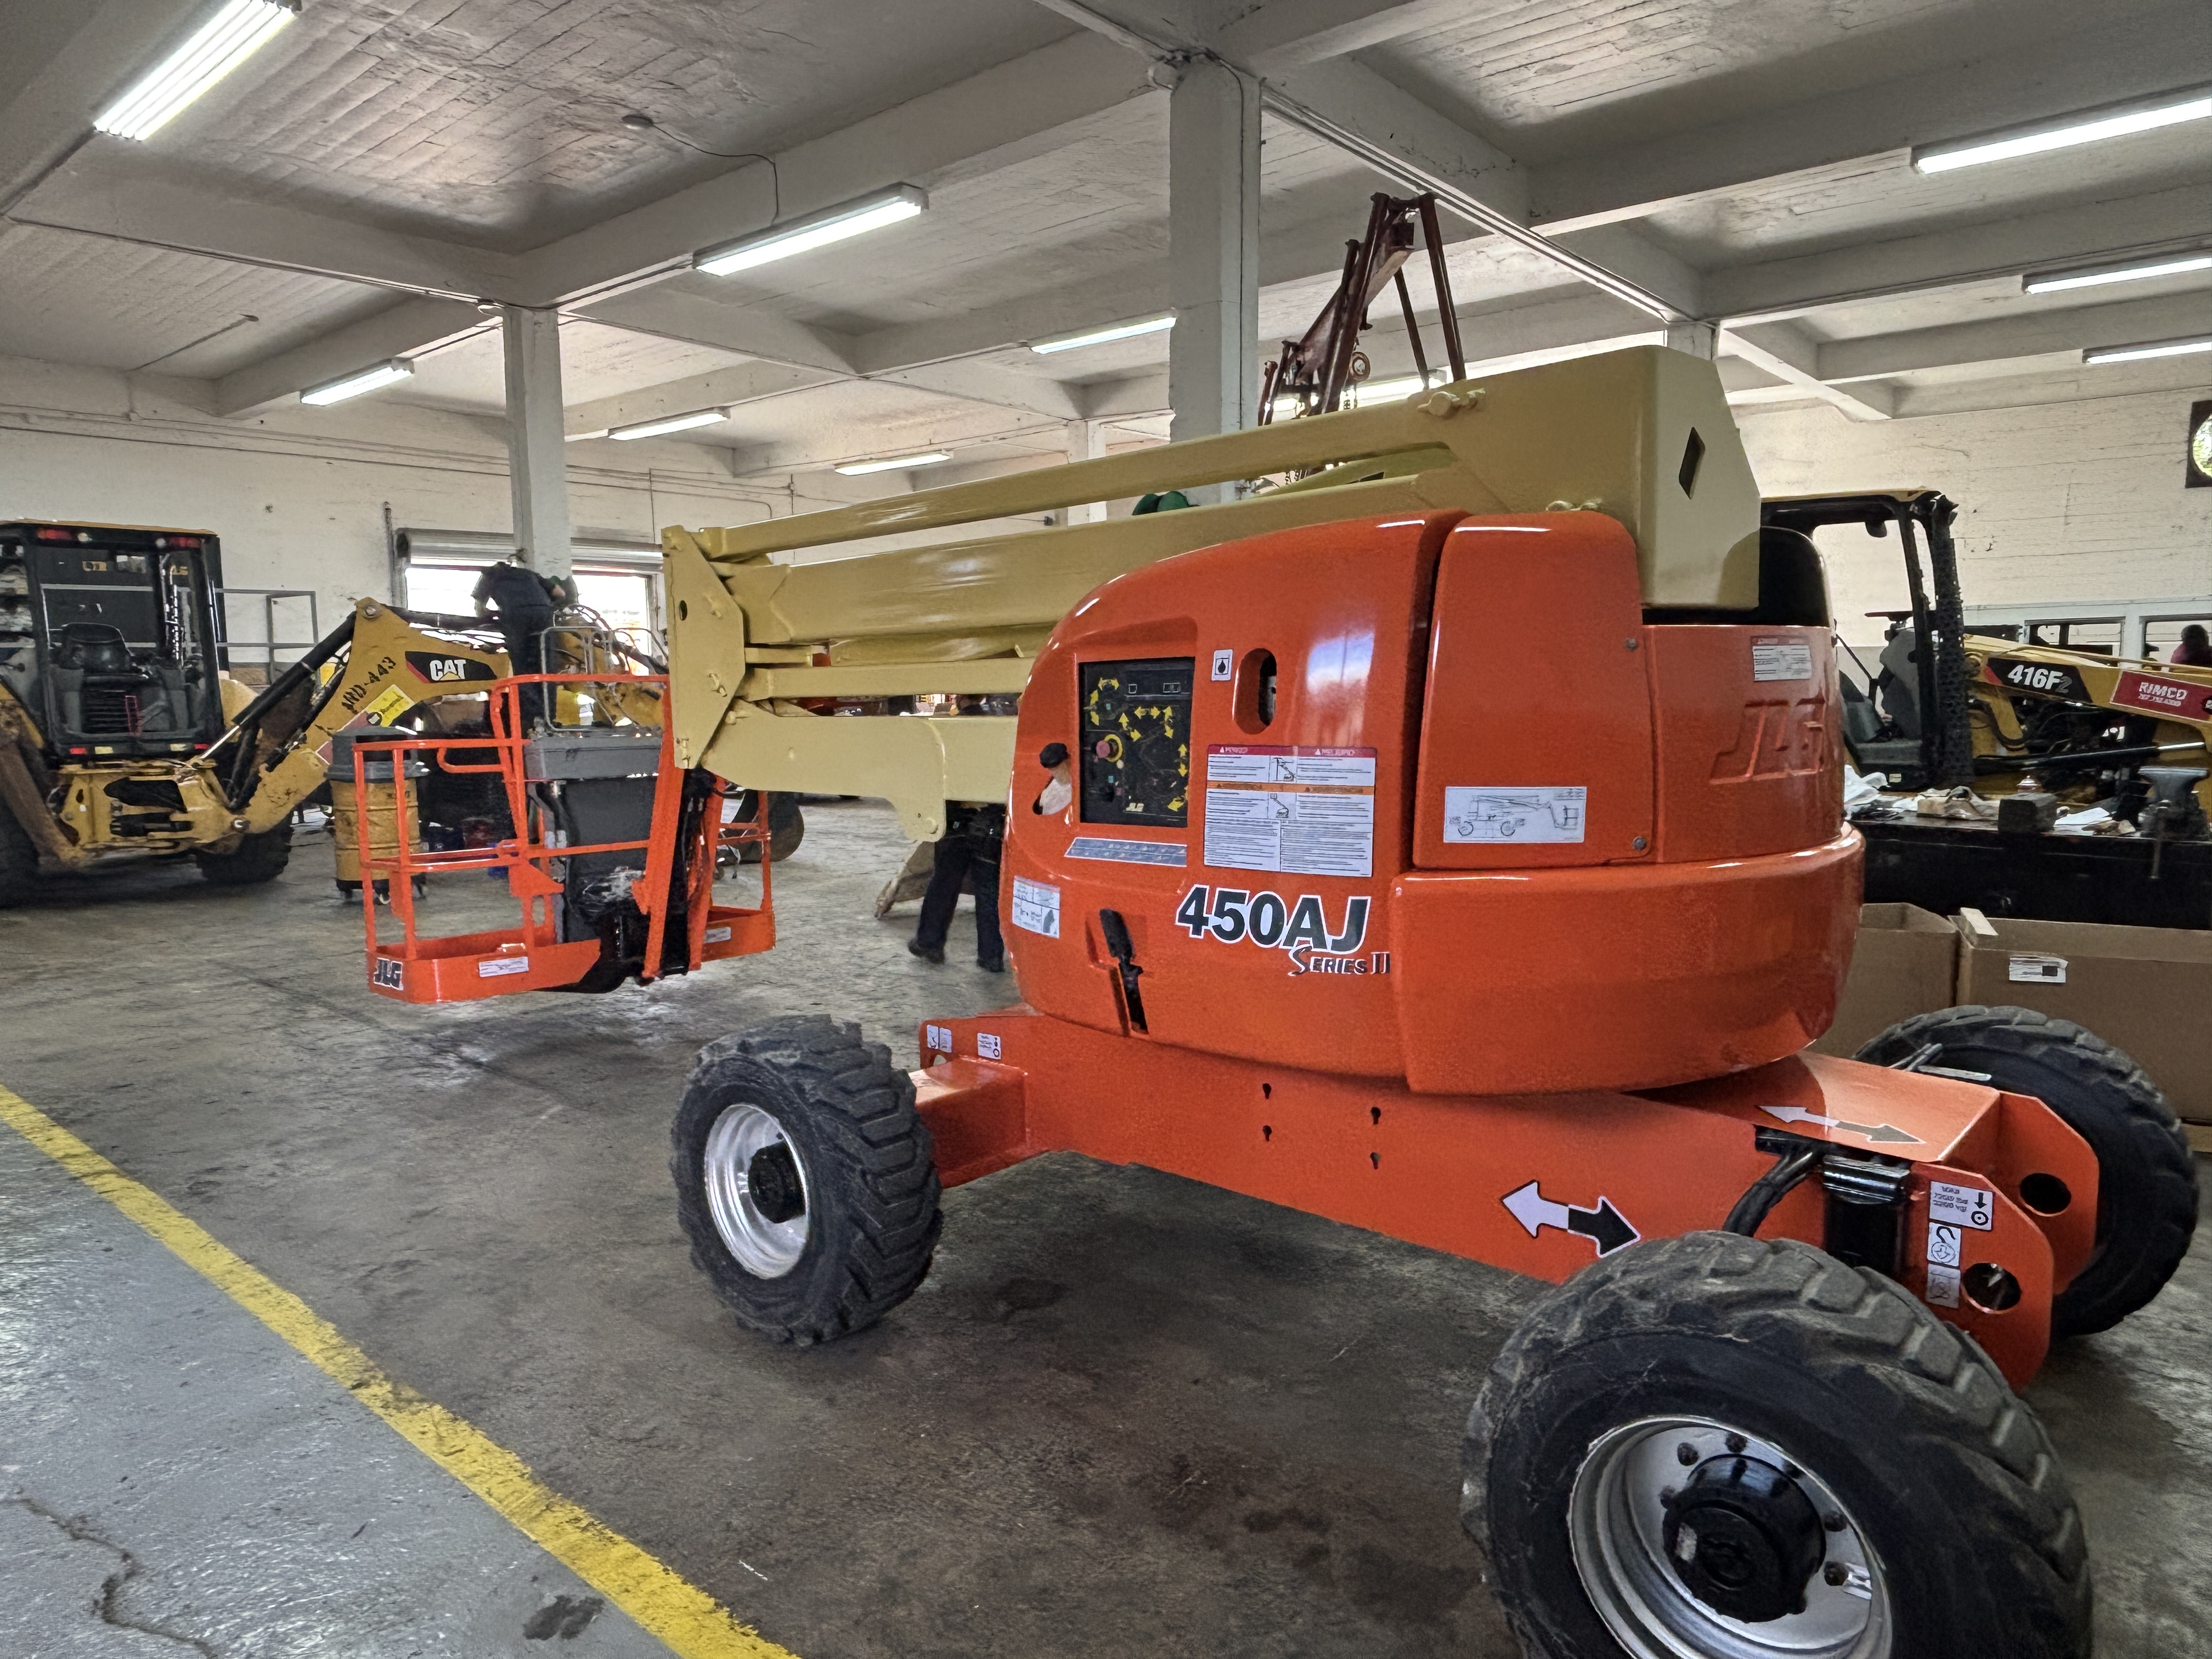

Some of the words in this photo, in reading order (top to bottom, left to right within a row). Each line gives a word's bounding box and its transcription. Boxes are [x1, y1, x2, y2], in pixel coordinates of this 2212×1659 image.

[430, 659, 466, 681] CAT
[2139, 681, 2188, 700] RIMCO
[1175, 884, 1372, 955] 450AJ
[373, 957, 404, 991] JLG
